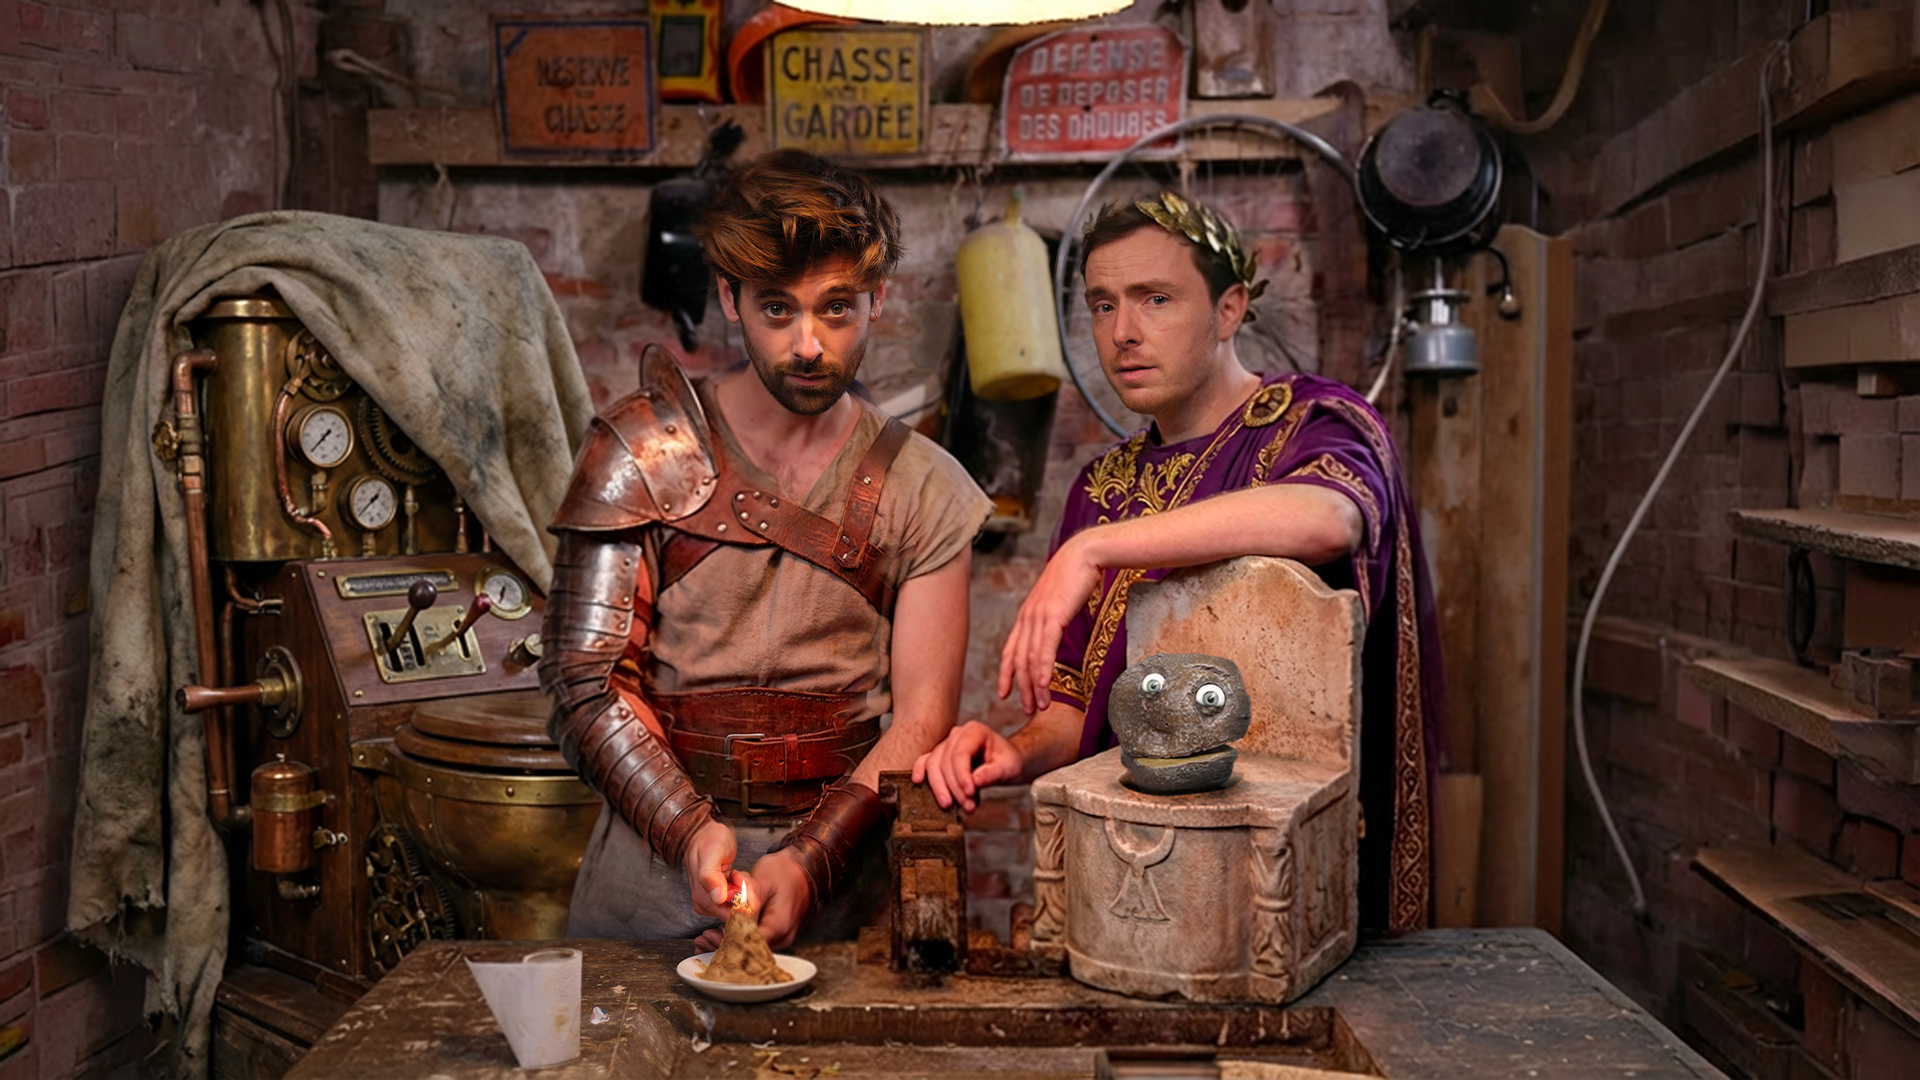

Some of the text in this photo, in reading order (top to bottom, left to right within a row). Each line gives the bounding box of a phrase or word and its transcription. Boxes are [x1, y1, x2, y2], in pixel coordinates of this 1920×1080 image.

[782, 46, 914, 83] CHASSE
[1029, 37, 1168, 76] DEFENSE
[1020, 77, 1170, 108] DE DEPOSER
[784, 97, 914, 140] GARDÉE
[1019, 114, 1061, 141] DES
